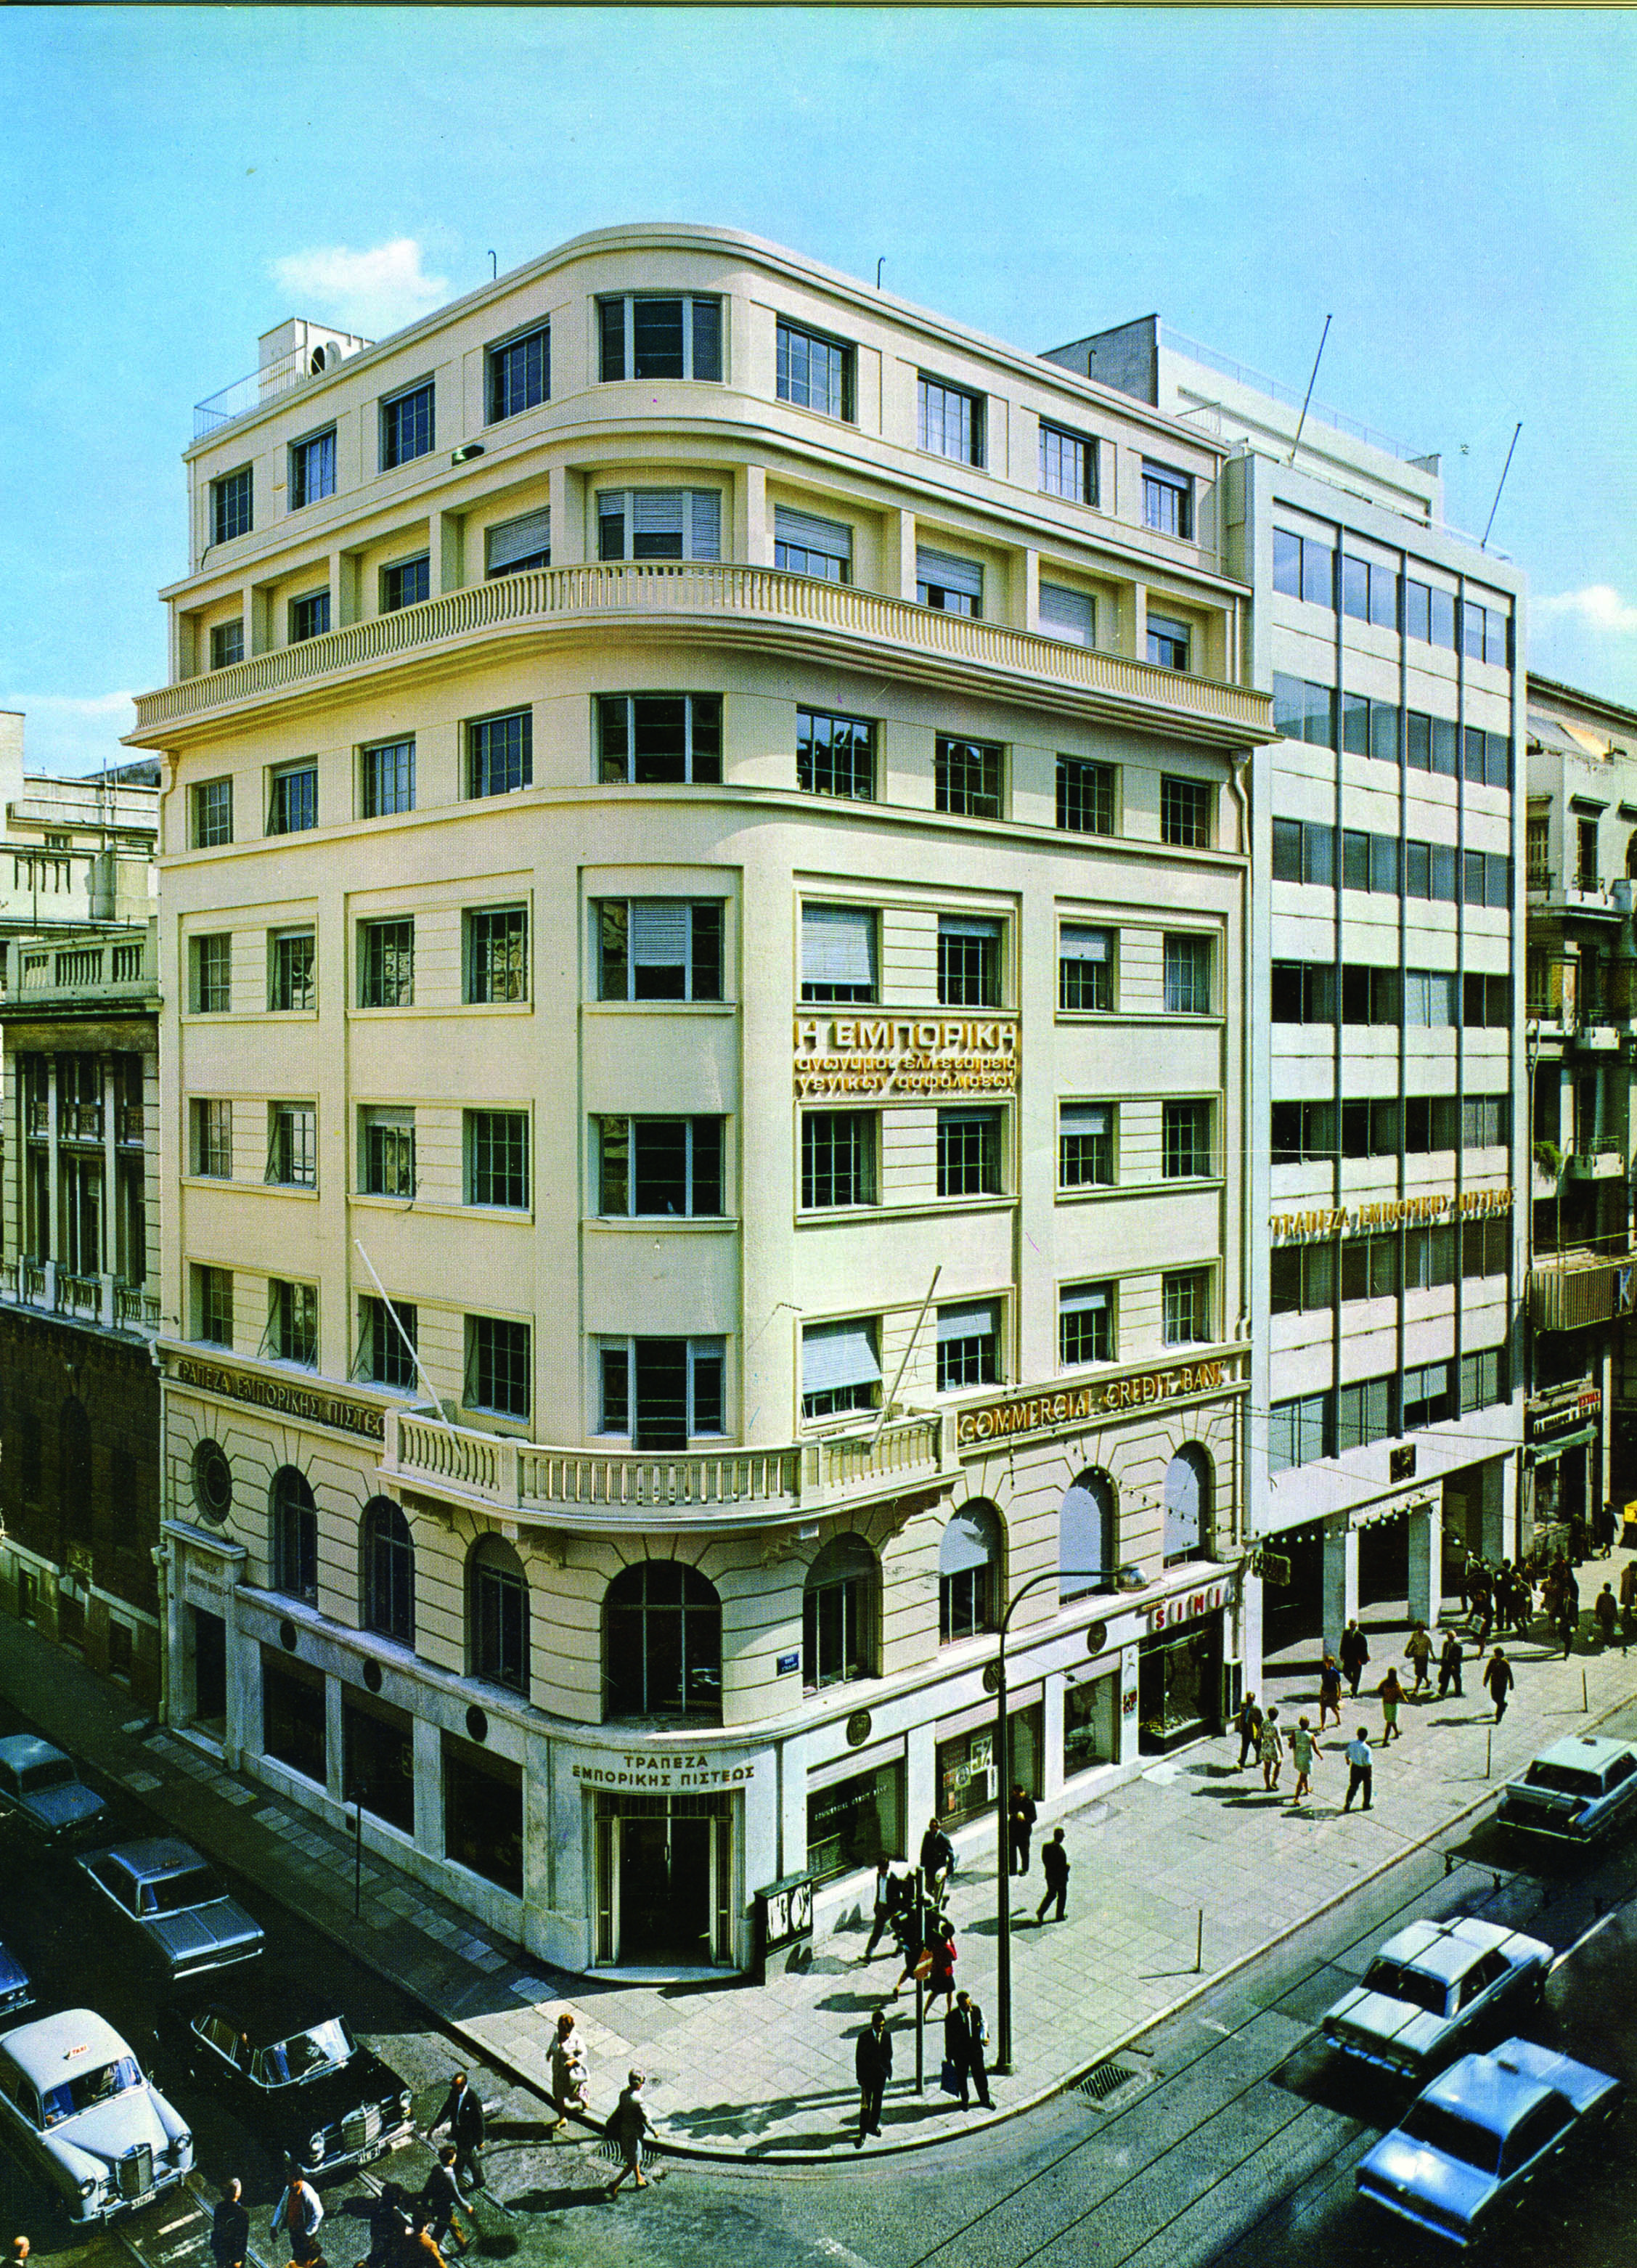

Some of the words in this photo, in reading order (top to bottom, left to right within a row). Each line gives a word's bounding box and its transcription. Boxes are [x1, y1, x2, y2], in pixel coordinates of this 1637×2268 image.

[799, 1021, 819, 1045] Η
[836, 1021, 1016, 1047] ΕΜΠΟΡΙΚΗ
[1271, 1206, 1350, 1237] ΤΡΑΠΕΖΑ
[1359, 1194, 1454, 1226] ΕΜΠΟΡΙΚΗΣ
[176, 1360, 230, 1392] ΤΡΑΠΕΖΑ
[237, 1376, 318, 1417] ΕΜΠΟΡΙΚΗΣ
[959, 1390, 1099, 1442] COMMERCIAL
[1104, 1371, 1175, 1406] CREDIT
[1181, 1361, 1227, 1391] BANK
[573, 1766, 671, 1786] ΕΜΠΟΡΙΚΗΣ
[681, 1766, 754, 1785] ΠΙΣΤΕΩΣ
[624, 1755, 708, 1769] ΤΡΑΠΕΖΑ
